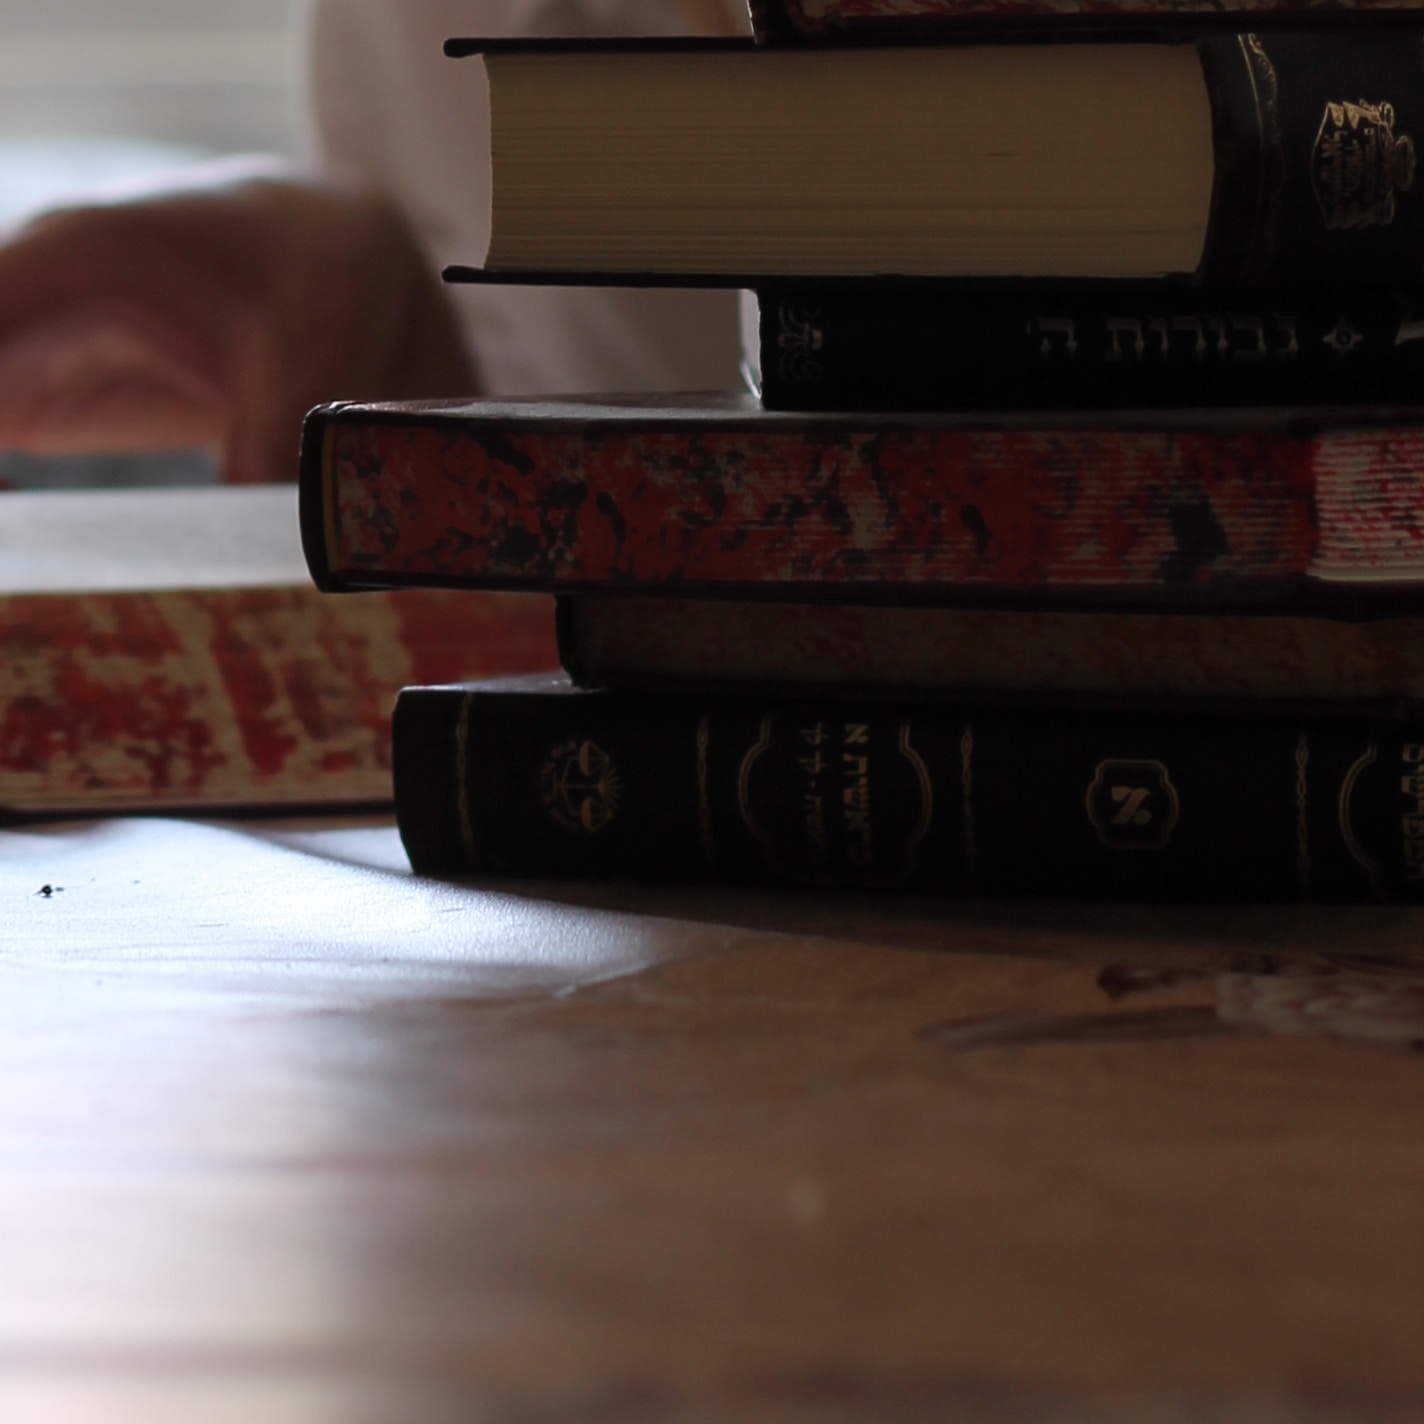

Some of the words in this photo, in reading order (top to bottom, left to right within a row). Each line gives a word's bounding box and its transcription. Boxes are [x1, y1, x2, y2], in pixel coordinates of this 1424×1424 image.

[1105, 310, 1298, 362] גבורות
[844, 723, 869, 744] א
[843, 753, 874, 865] בראשית
[1111, 785, 1153, 825] א
